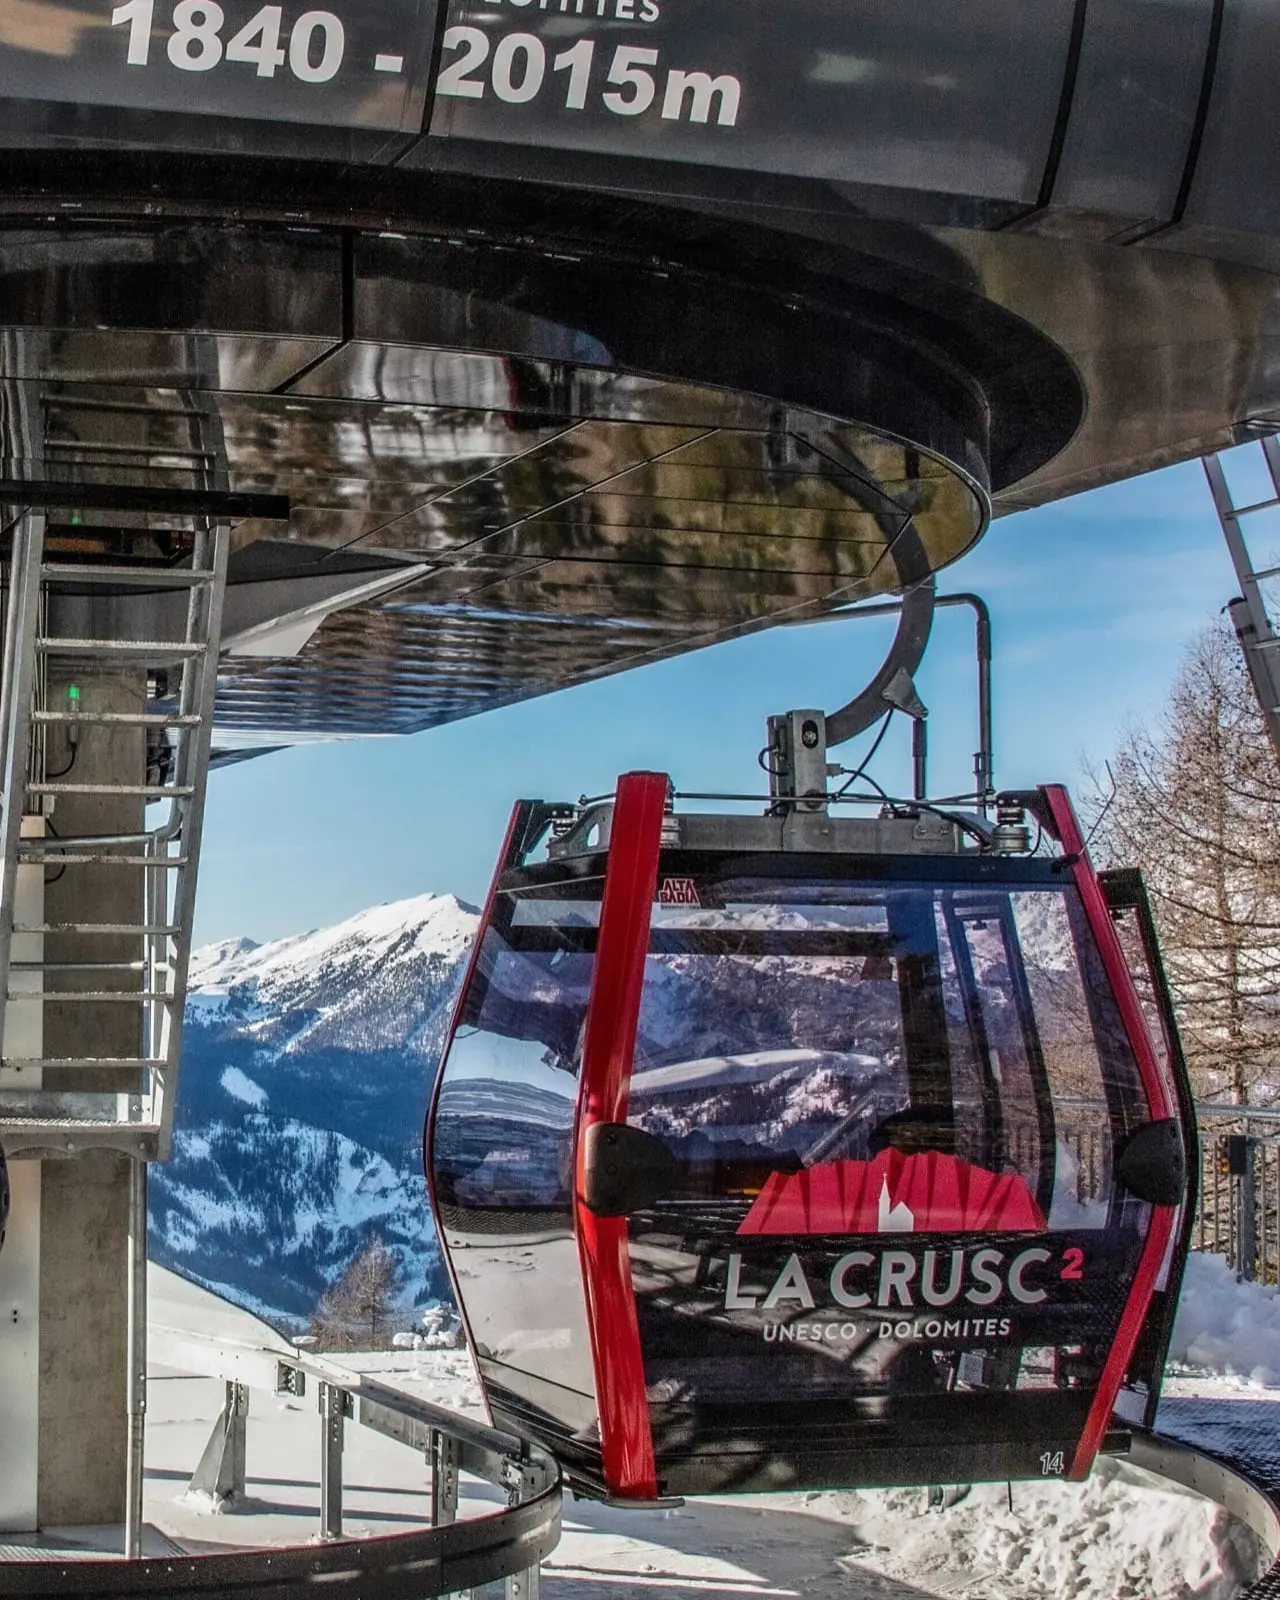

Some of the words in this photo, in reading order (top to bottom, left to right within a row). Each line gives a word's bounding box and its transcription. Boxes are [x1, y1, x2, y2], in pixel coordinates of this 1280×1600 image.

[111, 0, 345, 83] 1840
[435, 26, 742, 127] 2015m
[660, 892, 699, 904] BADIA
[664, 880, 695, 892] ALTA
[724, 1253, 815, 1309] LA
[763, 1322, 857, 1342] UNESCO
[879, 1318, 1011, 1339] DOLOMITES
[1040, 1451, 1065, 1475] 14
